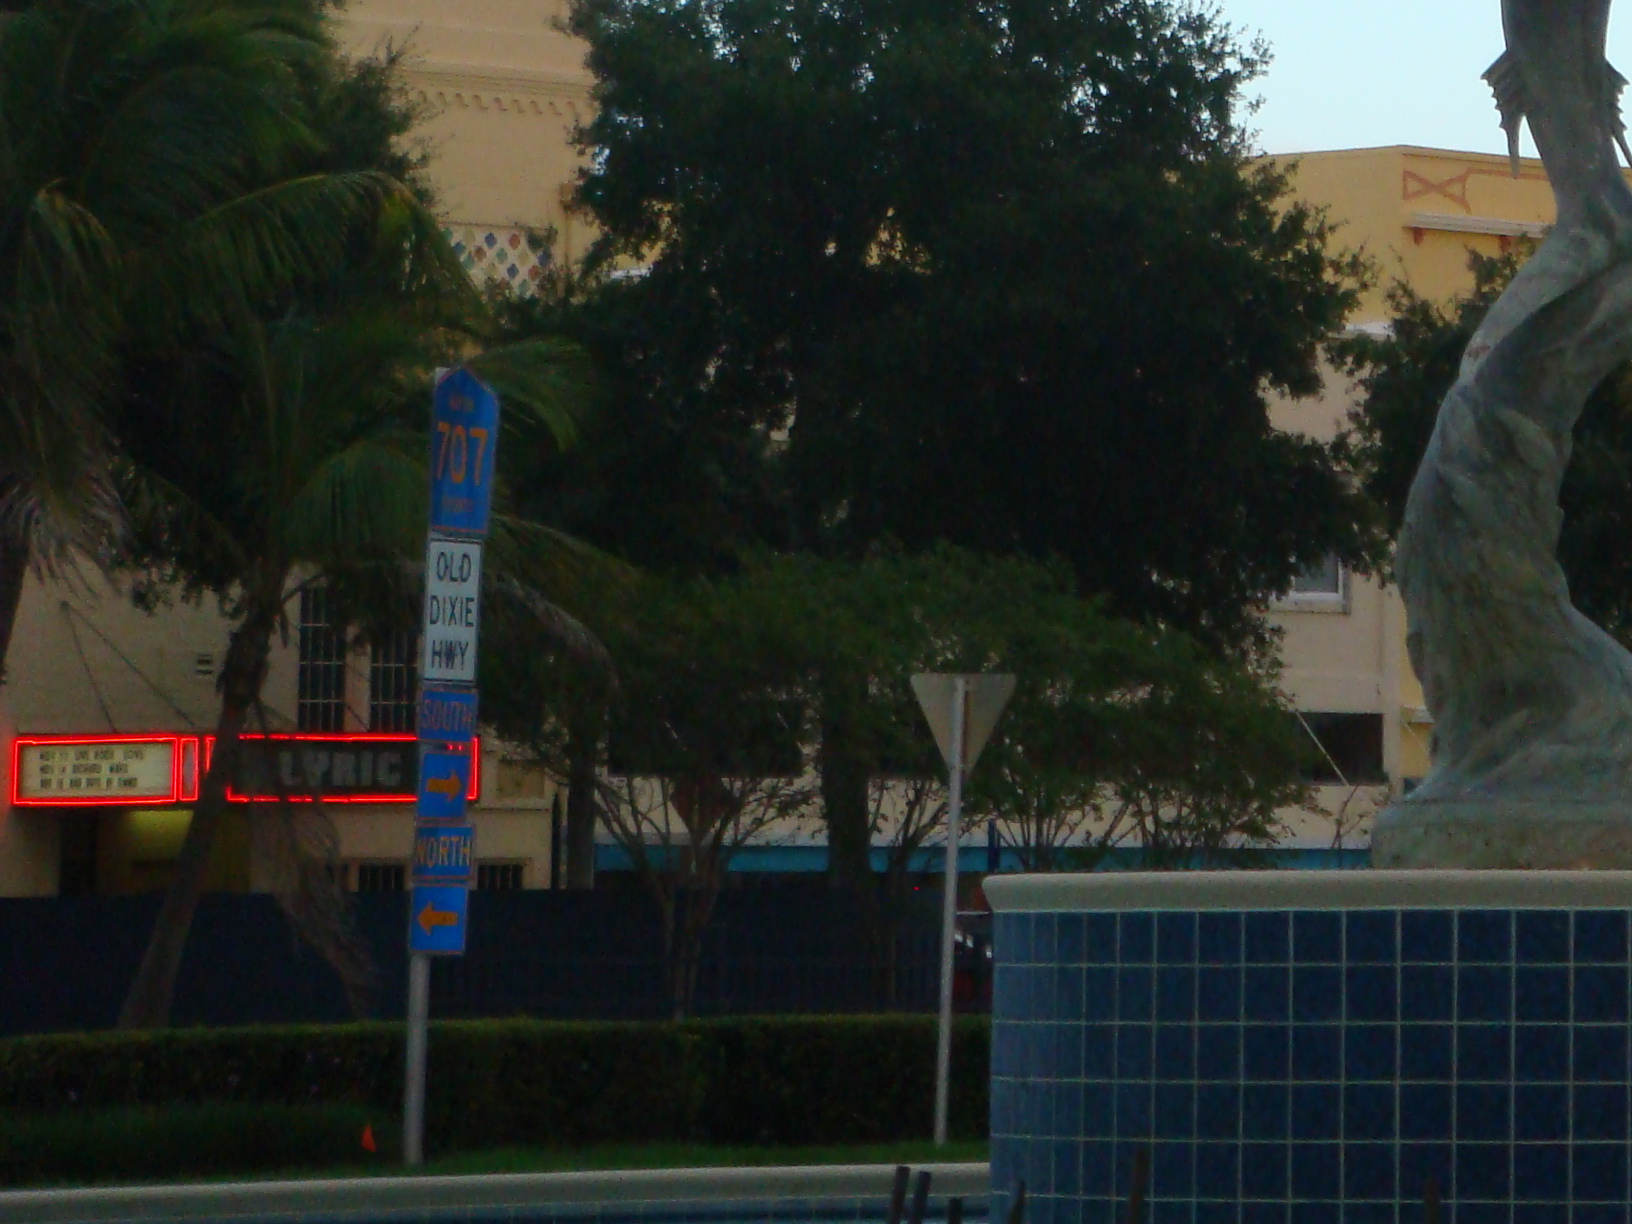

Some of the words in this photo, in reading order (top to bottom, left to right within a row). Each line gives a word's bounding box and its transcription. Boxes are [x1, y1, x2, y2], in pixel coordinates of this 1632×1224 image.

[437, 421, 488, 487] 707
[437, 551, 471, 583] OLD
[429, 595, 475, 627] DIXIE
[431, 639, 469, 670] HWY
[422, 698, 472, 733] SOUTH
[280, 749, 402, 787] LYRIC
[416, 833, 472, 868] NORTH
